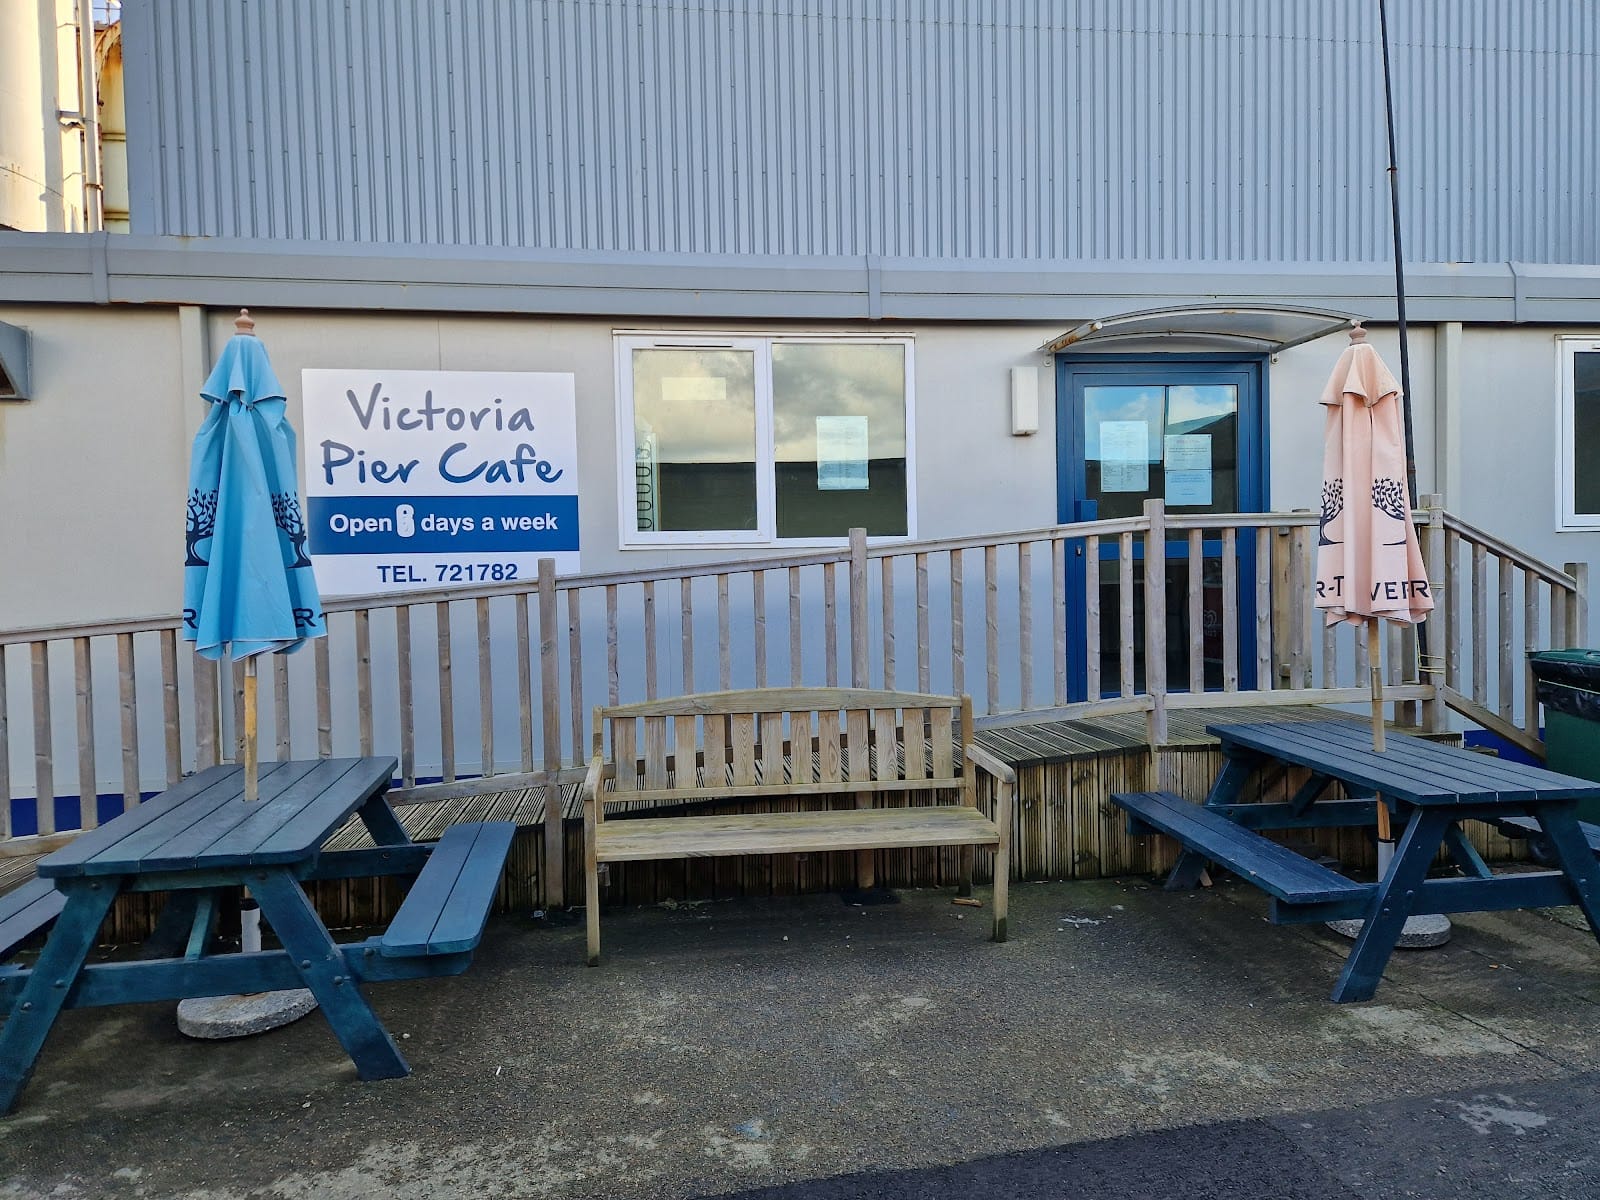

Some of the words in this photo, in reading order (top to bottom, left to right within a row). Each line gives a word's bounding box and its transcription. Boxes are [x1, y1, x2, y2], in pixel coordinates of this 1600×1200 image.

[346, 382, 535, 432] Victoria
[320, 439, 420, 485] Pier
[438, 442, 564, 484] Cafe
[329, 513, 392, 537] Open
[421, 513, 475, 536] days
[481, 516, 495, 531] a
[501, 512, 558, 531] week
[377, 565, 427, 583] TEL.
[434, 563, 518, 582] 721782
